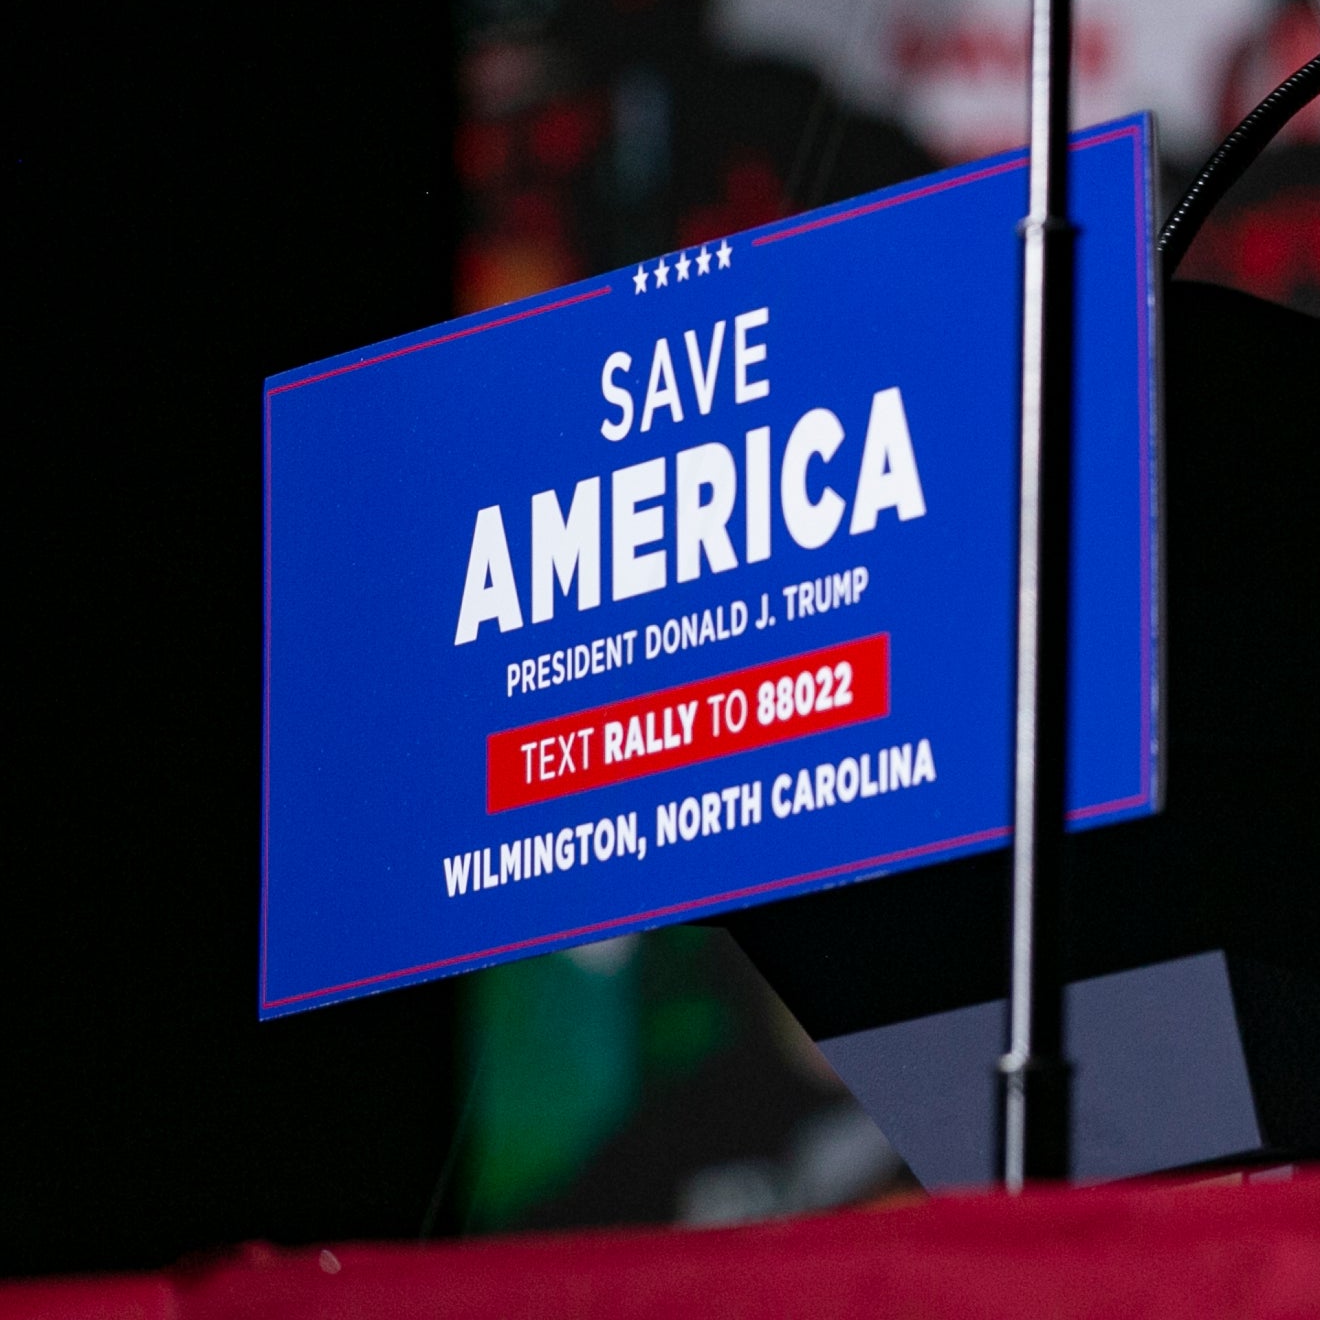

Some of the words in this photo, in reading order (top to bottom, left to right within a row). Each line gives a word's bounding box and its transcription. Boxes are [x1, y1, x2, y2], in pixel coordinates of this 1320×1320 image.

[599, 306, 771, 442] SAVE
[453, 385, 928, 647] AMERICA
[506, 629, 638, 699] PRESIDENT
[644, 599, 749, 661] DONALD
[754, 592, 777, 630] J.
[782, 566, 869, 621] TRUMP
[520, 727, 595, 785] TEXT
[603, 700, 699, 766] RALLY
[706, 688, 749, 738] TO
[756, 661, 854, 727] 88022
[442, 810, 647, 898] WILMINGTON,
[655, 779, 763, 848] NORTH
[770, 737, 937, 820] CAROLINA
